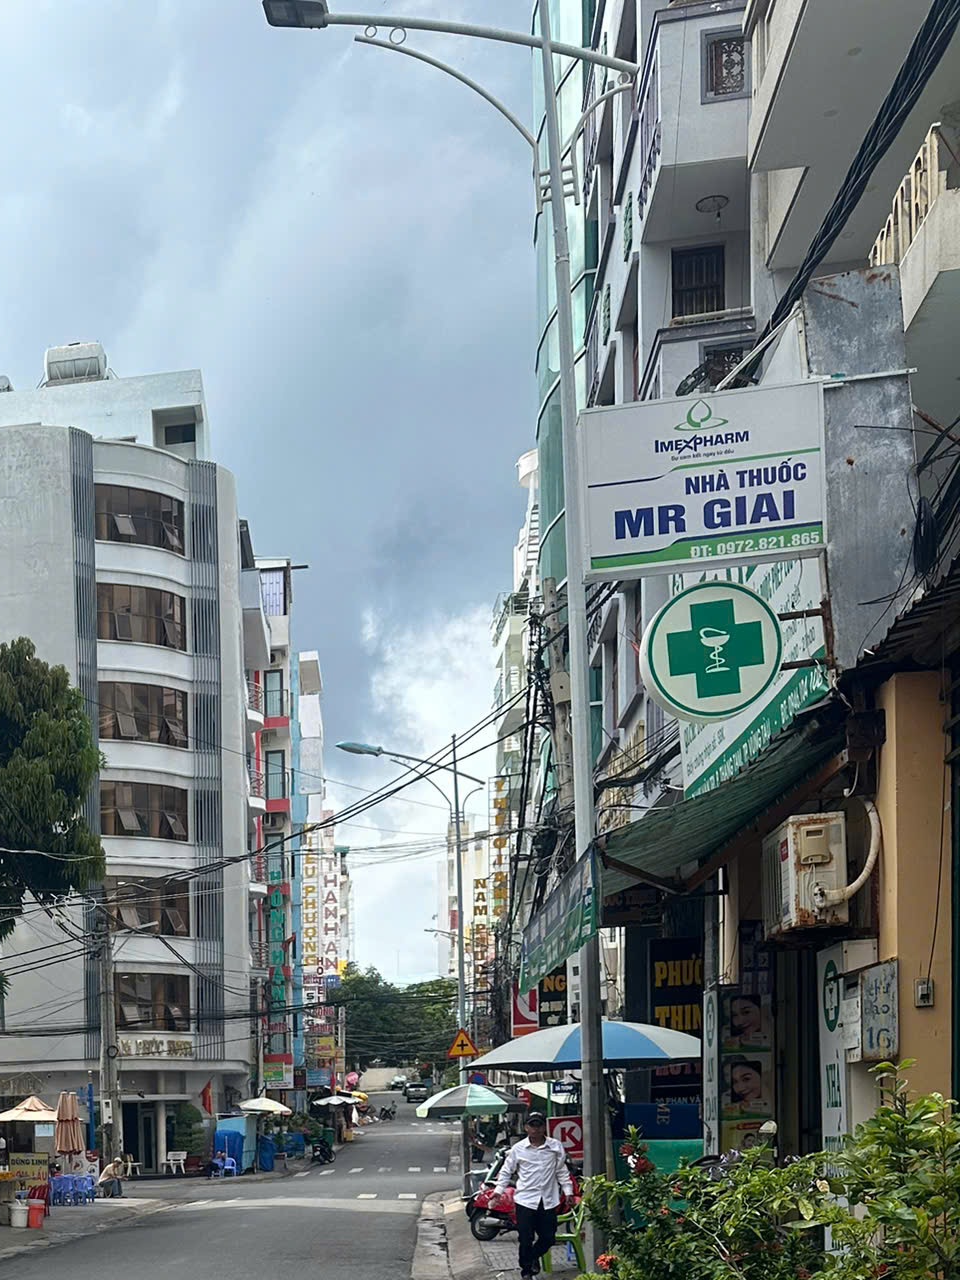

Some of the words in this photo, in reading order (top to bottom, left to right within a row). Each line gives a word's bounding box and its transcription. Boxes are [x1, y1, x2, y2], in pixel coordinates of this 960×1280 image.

[654, 430, 750, 454] IMEXPHARM
[685, 469, 730, 495] NHÀ
[736, 458, 807, 489] THUỐC
[614, 504, 686, 540] MR
[703, 490, 795, 530] GIAI
[716, 531, 820, 557] 0972.821.865
[474, 879, 489, 916] NAM
